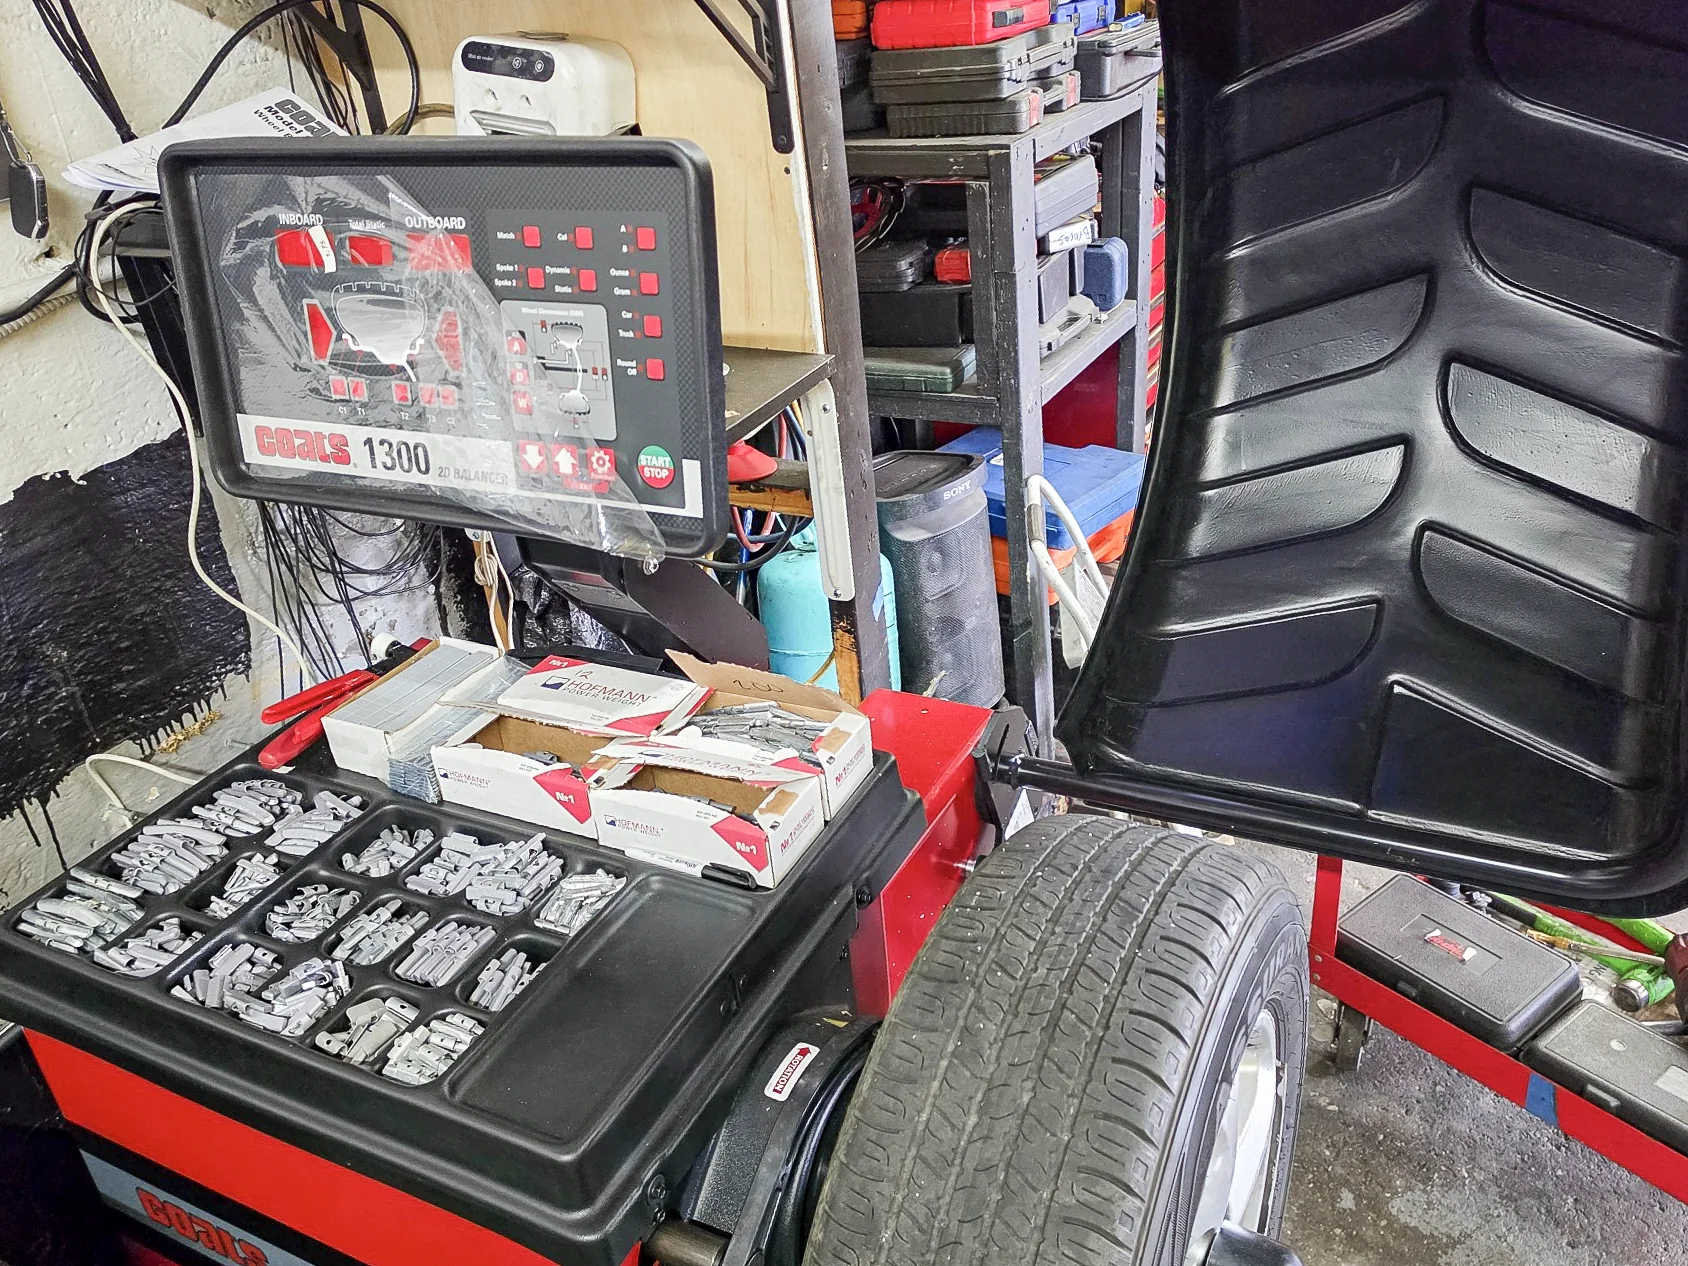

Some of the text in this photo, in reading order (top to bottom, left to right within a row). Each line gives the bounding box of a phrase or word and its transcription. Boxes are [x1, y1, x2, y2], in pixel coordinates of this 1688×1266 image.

[253, 109, 284, 134] Wheel
[262, 105, 304, 134] Model
[278, 213, 323, 226] INBOARD
[348, 219, 386, 229] Total Static
[405, 216, 466, 230] OUTBOARD
[620, 224, 626, 233] A
[497, 231, 515, 240] Match
[557, 233, 567, 241] Cal
[496, 264, 513, 272] Spoke
[545, 266, 571, 274] Dynamic
[609, 268, 630, 277] Ounce
[494, 279, 517, 287] Spoke 2
[554, 285, 572, 294] Static
[613, 287, 631, 296] Gram
[621, 310, 633, 319] Car
[618, 329, 634, 338] Truck
[513, 341, 521, 351] A
[616, 358, 637, 367] Round
[516, 372, 524, 383] D
[517, 397, 528, 409] W
[338, 406, 347, 415] C1
[357, 407, 366, 416] T1
[400, 412, 410, 421] T2
[363, 436, 431, 476] 1300
[438, 465, 450, 478] 2D
[453, 467, 509, 485] BALANCER
[639, 454, 671, 469] START
[643, 467, 670, 480] STOP
[943, 480, 971, 500] SONY
[567, 680, 650, 703] HOFMANN
[561, 687, 643, 707] POWER WEIGHT
[449, 769, 490, 785] HOFMANN
[615, 818, 660, 834] HOFMANN
[775, 1054, 804, 1092] ROTATION
